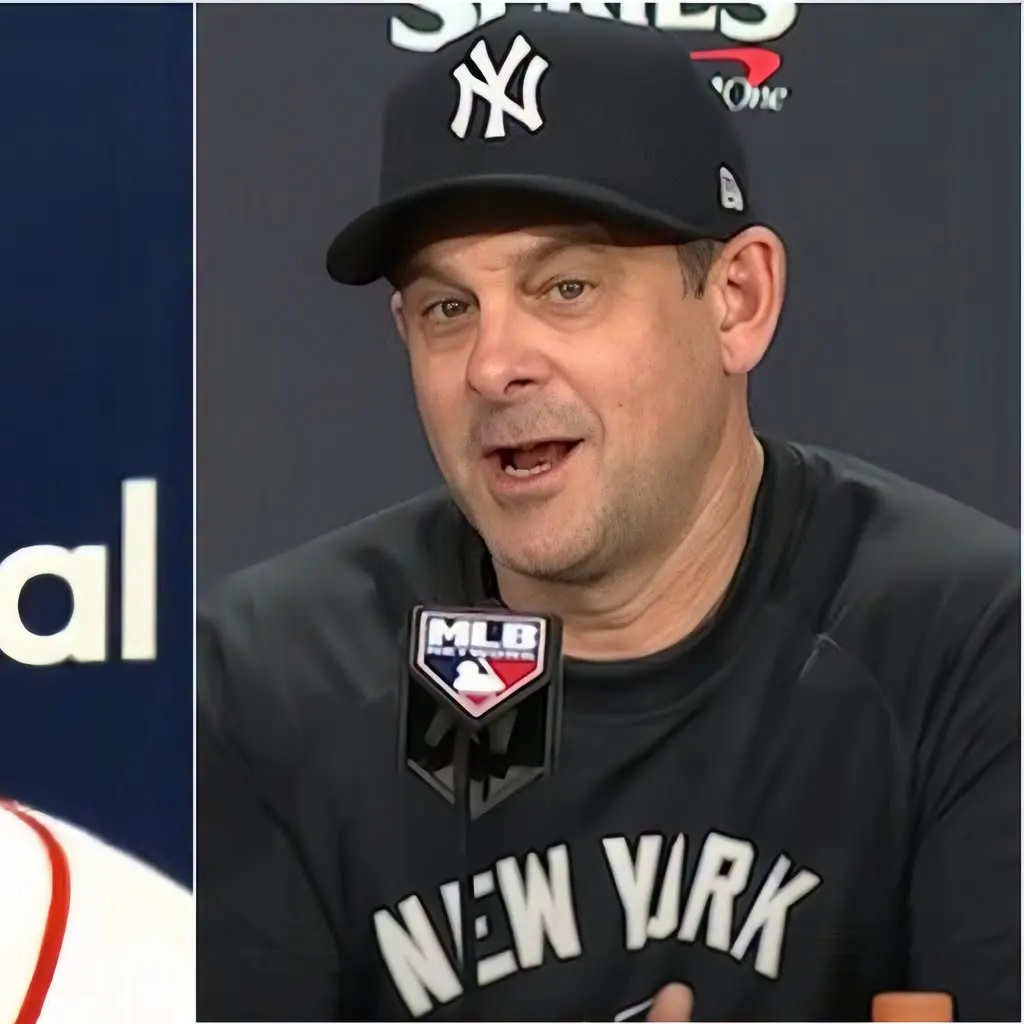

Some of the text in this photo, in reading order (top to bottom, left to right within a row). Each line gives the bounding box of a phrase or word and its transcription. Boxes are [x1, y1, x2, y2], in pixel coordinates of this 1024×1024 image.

[450, 34, 550, 139] NY
[427, 617, 539, 650] MLB
[373, 843, 582, 1018] NEW
